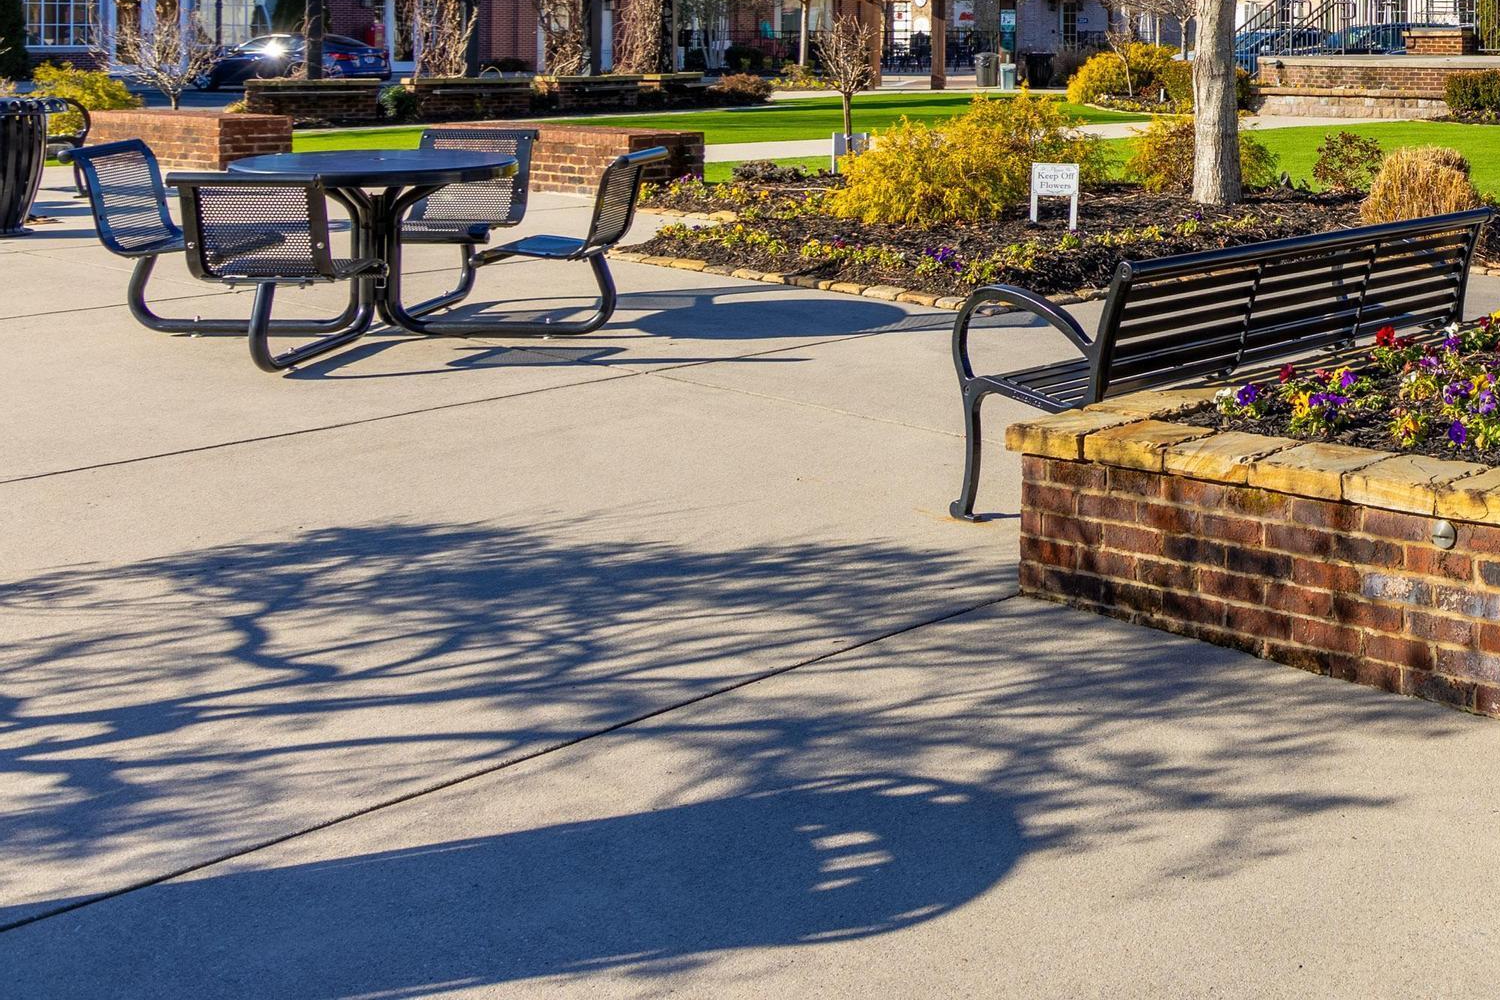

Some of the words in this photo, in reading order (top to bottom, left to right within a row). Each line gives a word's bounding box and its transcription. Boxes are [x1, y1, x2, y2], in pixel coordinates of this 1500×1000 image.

[1037, 171, 1059, 181] Keep
[1061, 172, 1075, 180] Off
[1040, 181, 1072, 190] Flowers
